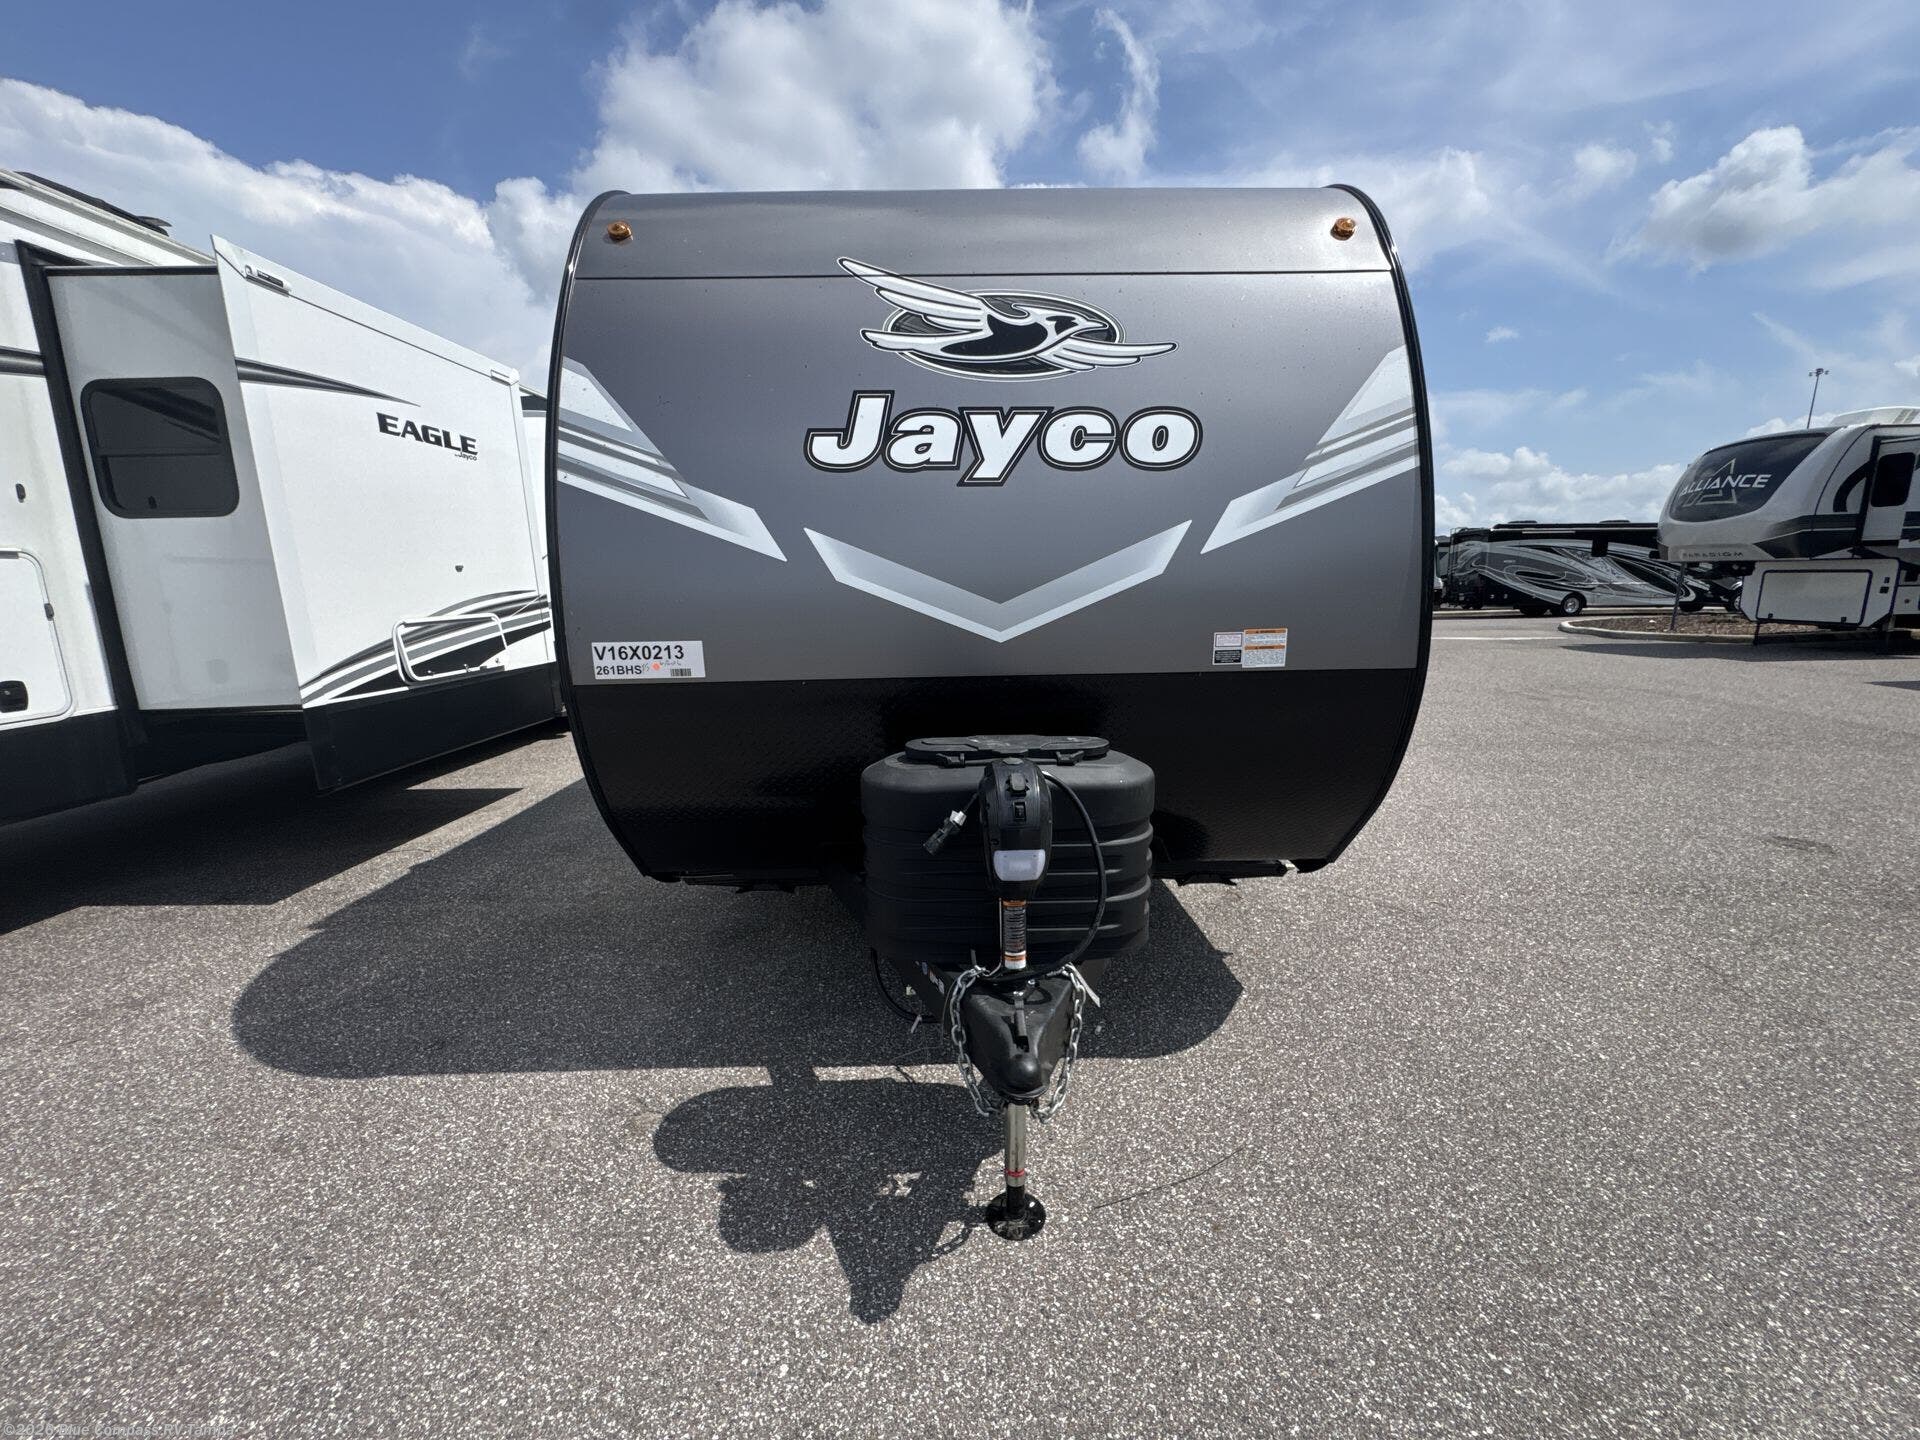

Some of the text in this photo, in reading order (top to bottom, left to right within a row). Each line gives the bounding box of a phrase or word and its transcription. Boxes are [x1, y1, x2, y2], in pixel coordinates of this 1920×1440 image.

[376, 412, 478, 455] EAGLE
[803, 390, 1204, 487] Jayco
[458, 452, 478, 461] Jayco
[1678, 474, 1772, 496] ALLIANCE
[594, 645, 684, 660] V16X0213
[596, 665, 642, 675] 261BHS
